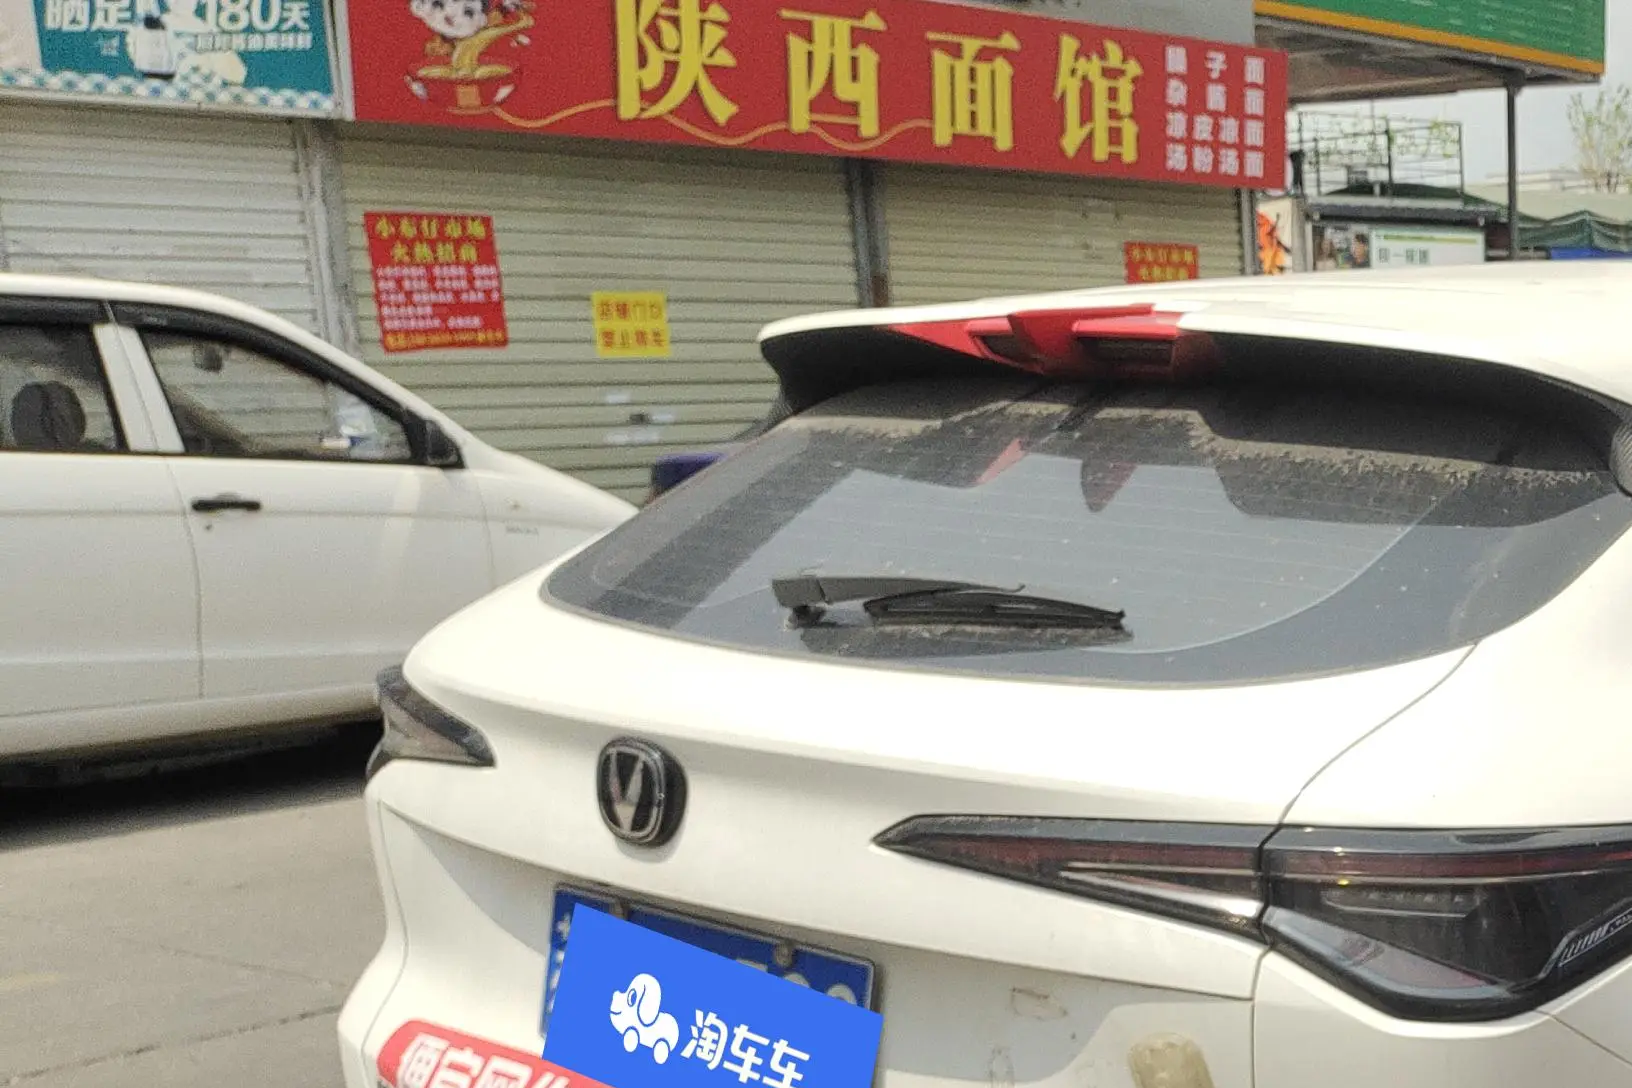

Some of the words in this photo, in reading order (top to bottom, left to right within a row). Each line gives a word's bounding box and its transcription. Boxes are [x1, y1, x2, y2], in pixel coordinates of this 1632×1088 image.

[614, 0, 1144, 163] 陕西面馆
[1165, 110, 1265, 148] 凉皮凉面
[1165, 142, 1265, 179] 汤粉汤面
